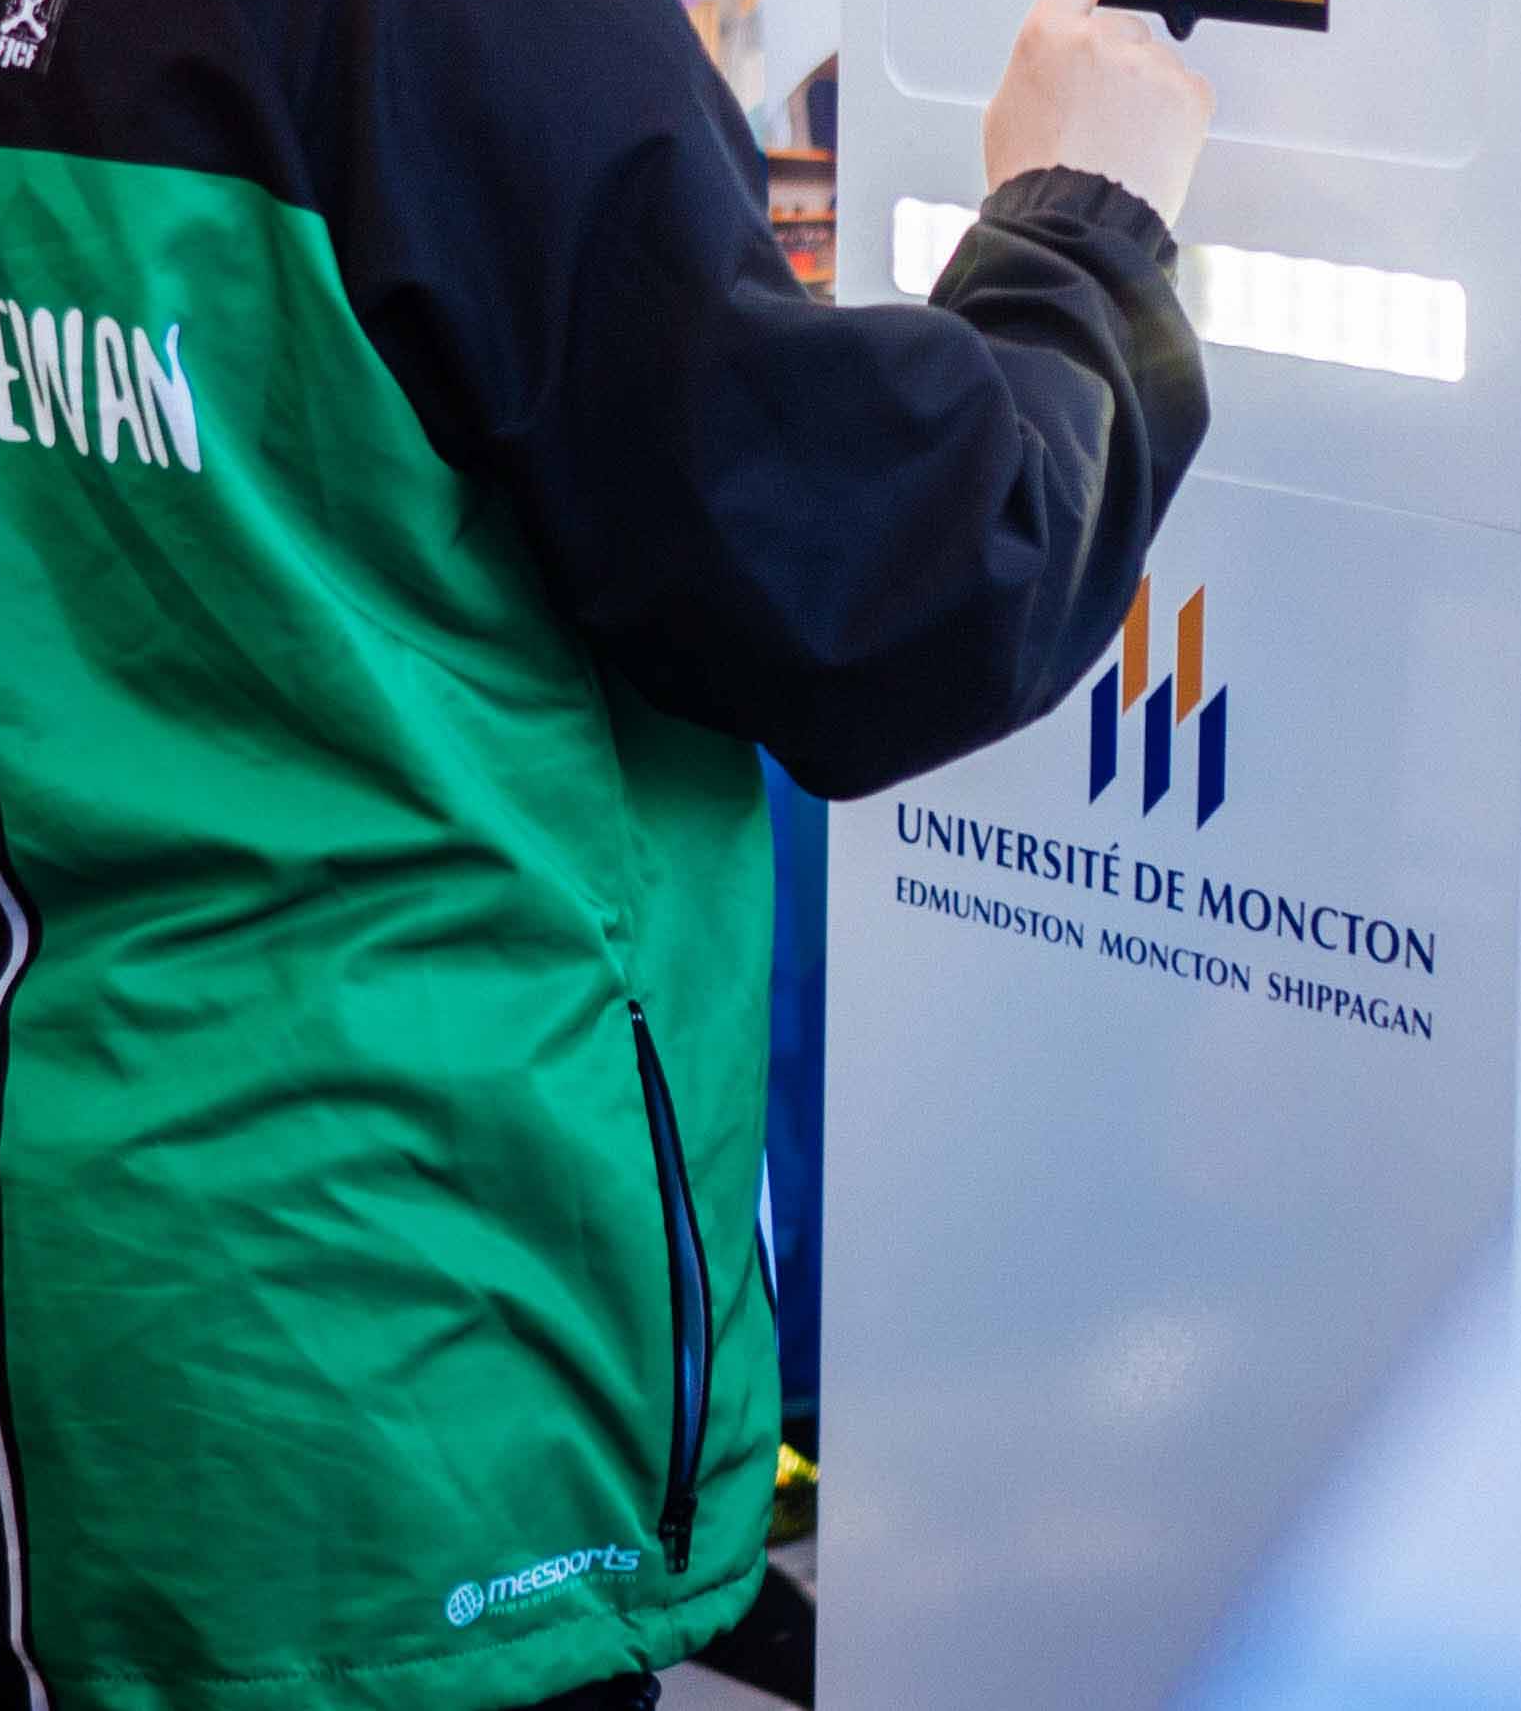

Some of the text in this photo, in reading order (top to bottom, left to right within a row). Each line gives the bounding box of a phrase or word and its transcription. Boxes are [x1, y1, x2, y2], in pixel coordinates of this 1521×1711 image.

[895, 875, 1433, 1041] EDMUNDSTON MONCTON SHIPPAGAN
[897, 801, 1436, 976] UNIVERSITÉ DE MONCTON
[489, 1543, 641, 1603] meesports
